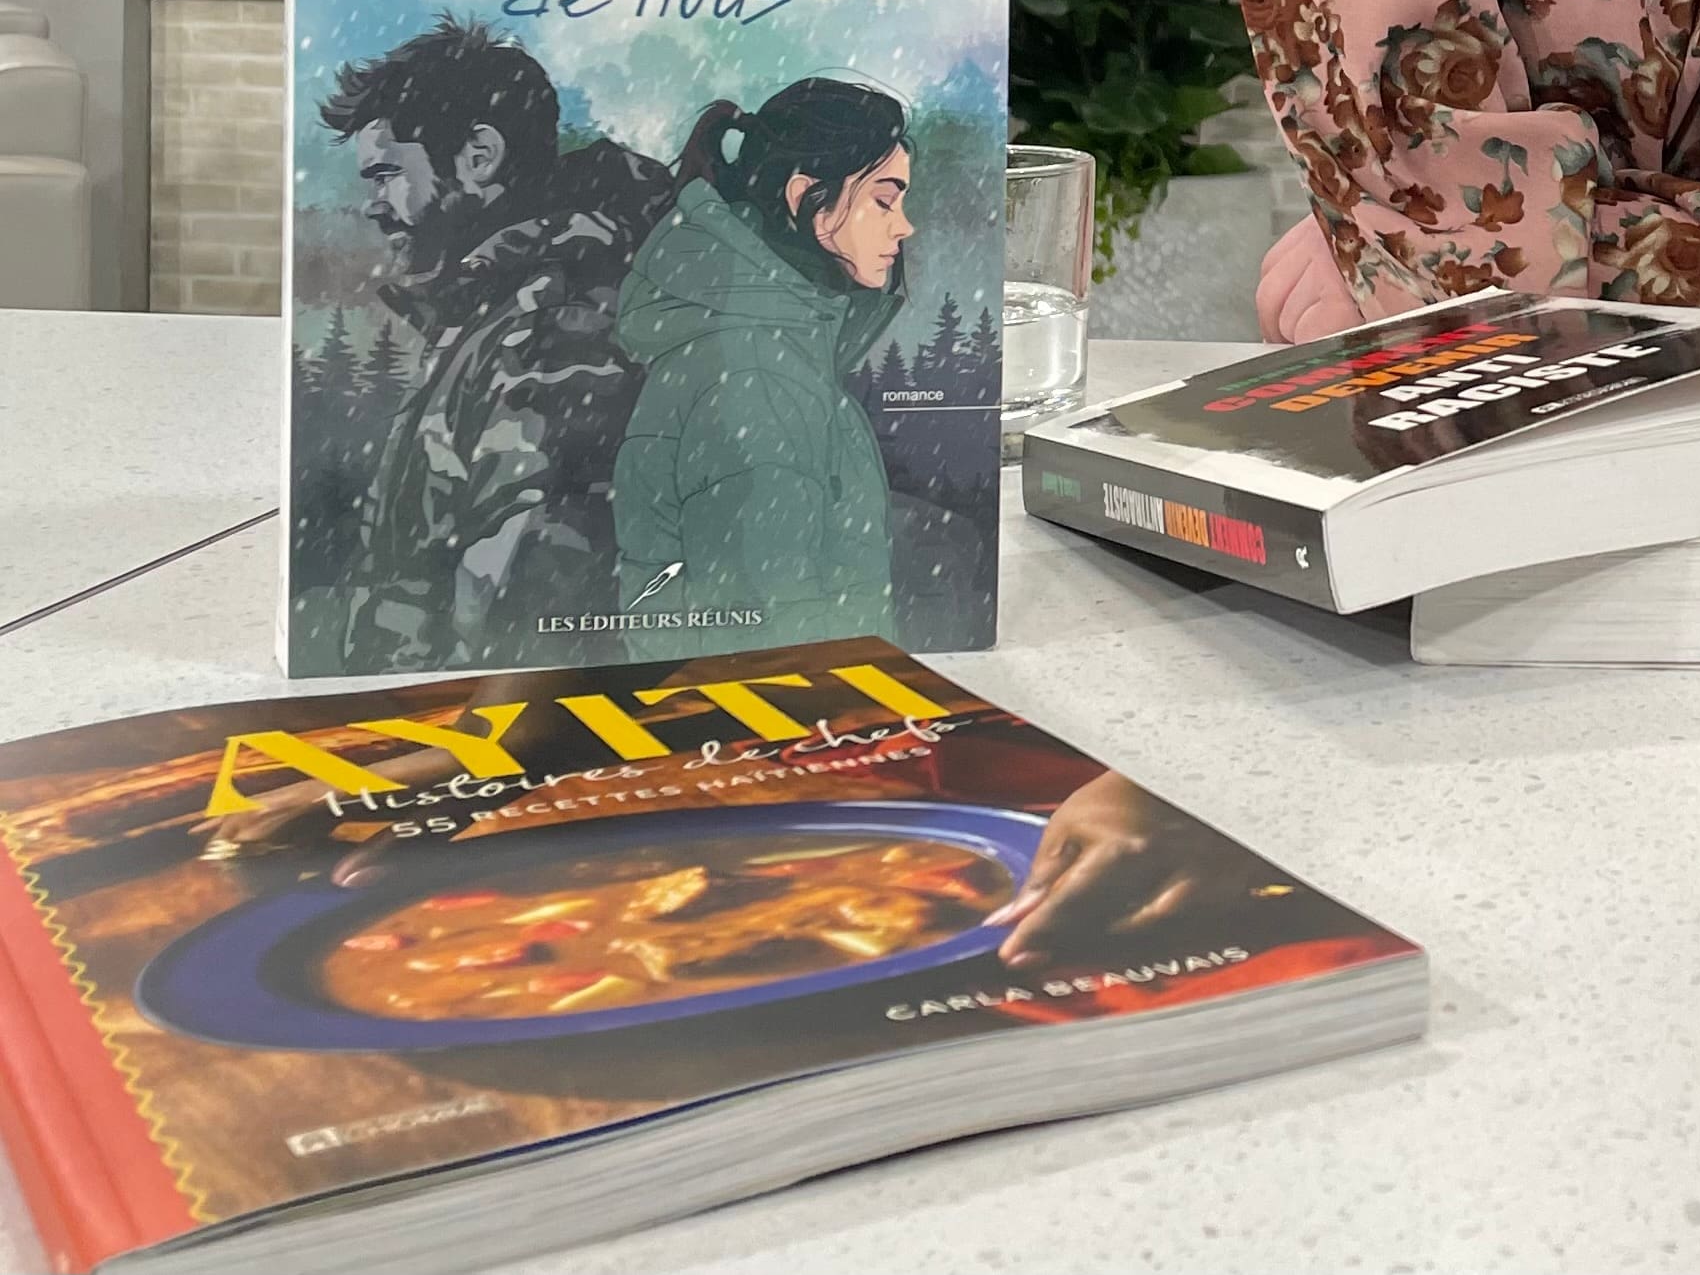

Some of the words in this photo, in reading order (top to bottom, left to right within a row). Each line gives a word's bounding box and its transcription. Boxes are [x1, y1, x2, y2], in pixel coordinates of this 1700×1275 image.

[883, 389, 944, 402] romance
[1270, 333, 1540, 412] DEVENIR
[1368, 343, 1662, 431] RACISTE
[1379, 353, 1542, 403] ANTI
[538, 616, 575, 633] LES
[579, 611, 683, 631] ÉDITEURS
[687, 608, 763, 627] RÉUNIS
[204, 663, 952, 818] AYITI
[312, 764, 664, 818] Histoires
[683, 740, 780, 770] de
[391, 817, 458, 839] 55
[470, 784, 682, 823] RECETTES
[885, 985, 1034, 1022] CARLA
[1043, 945, 1251, 997] BEAUVAIS
